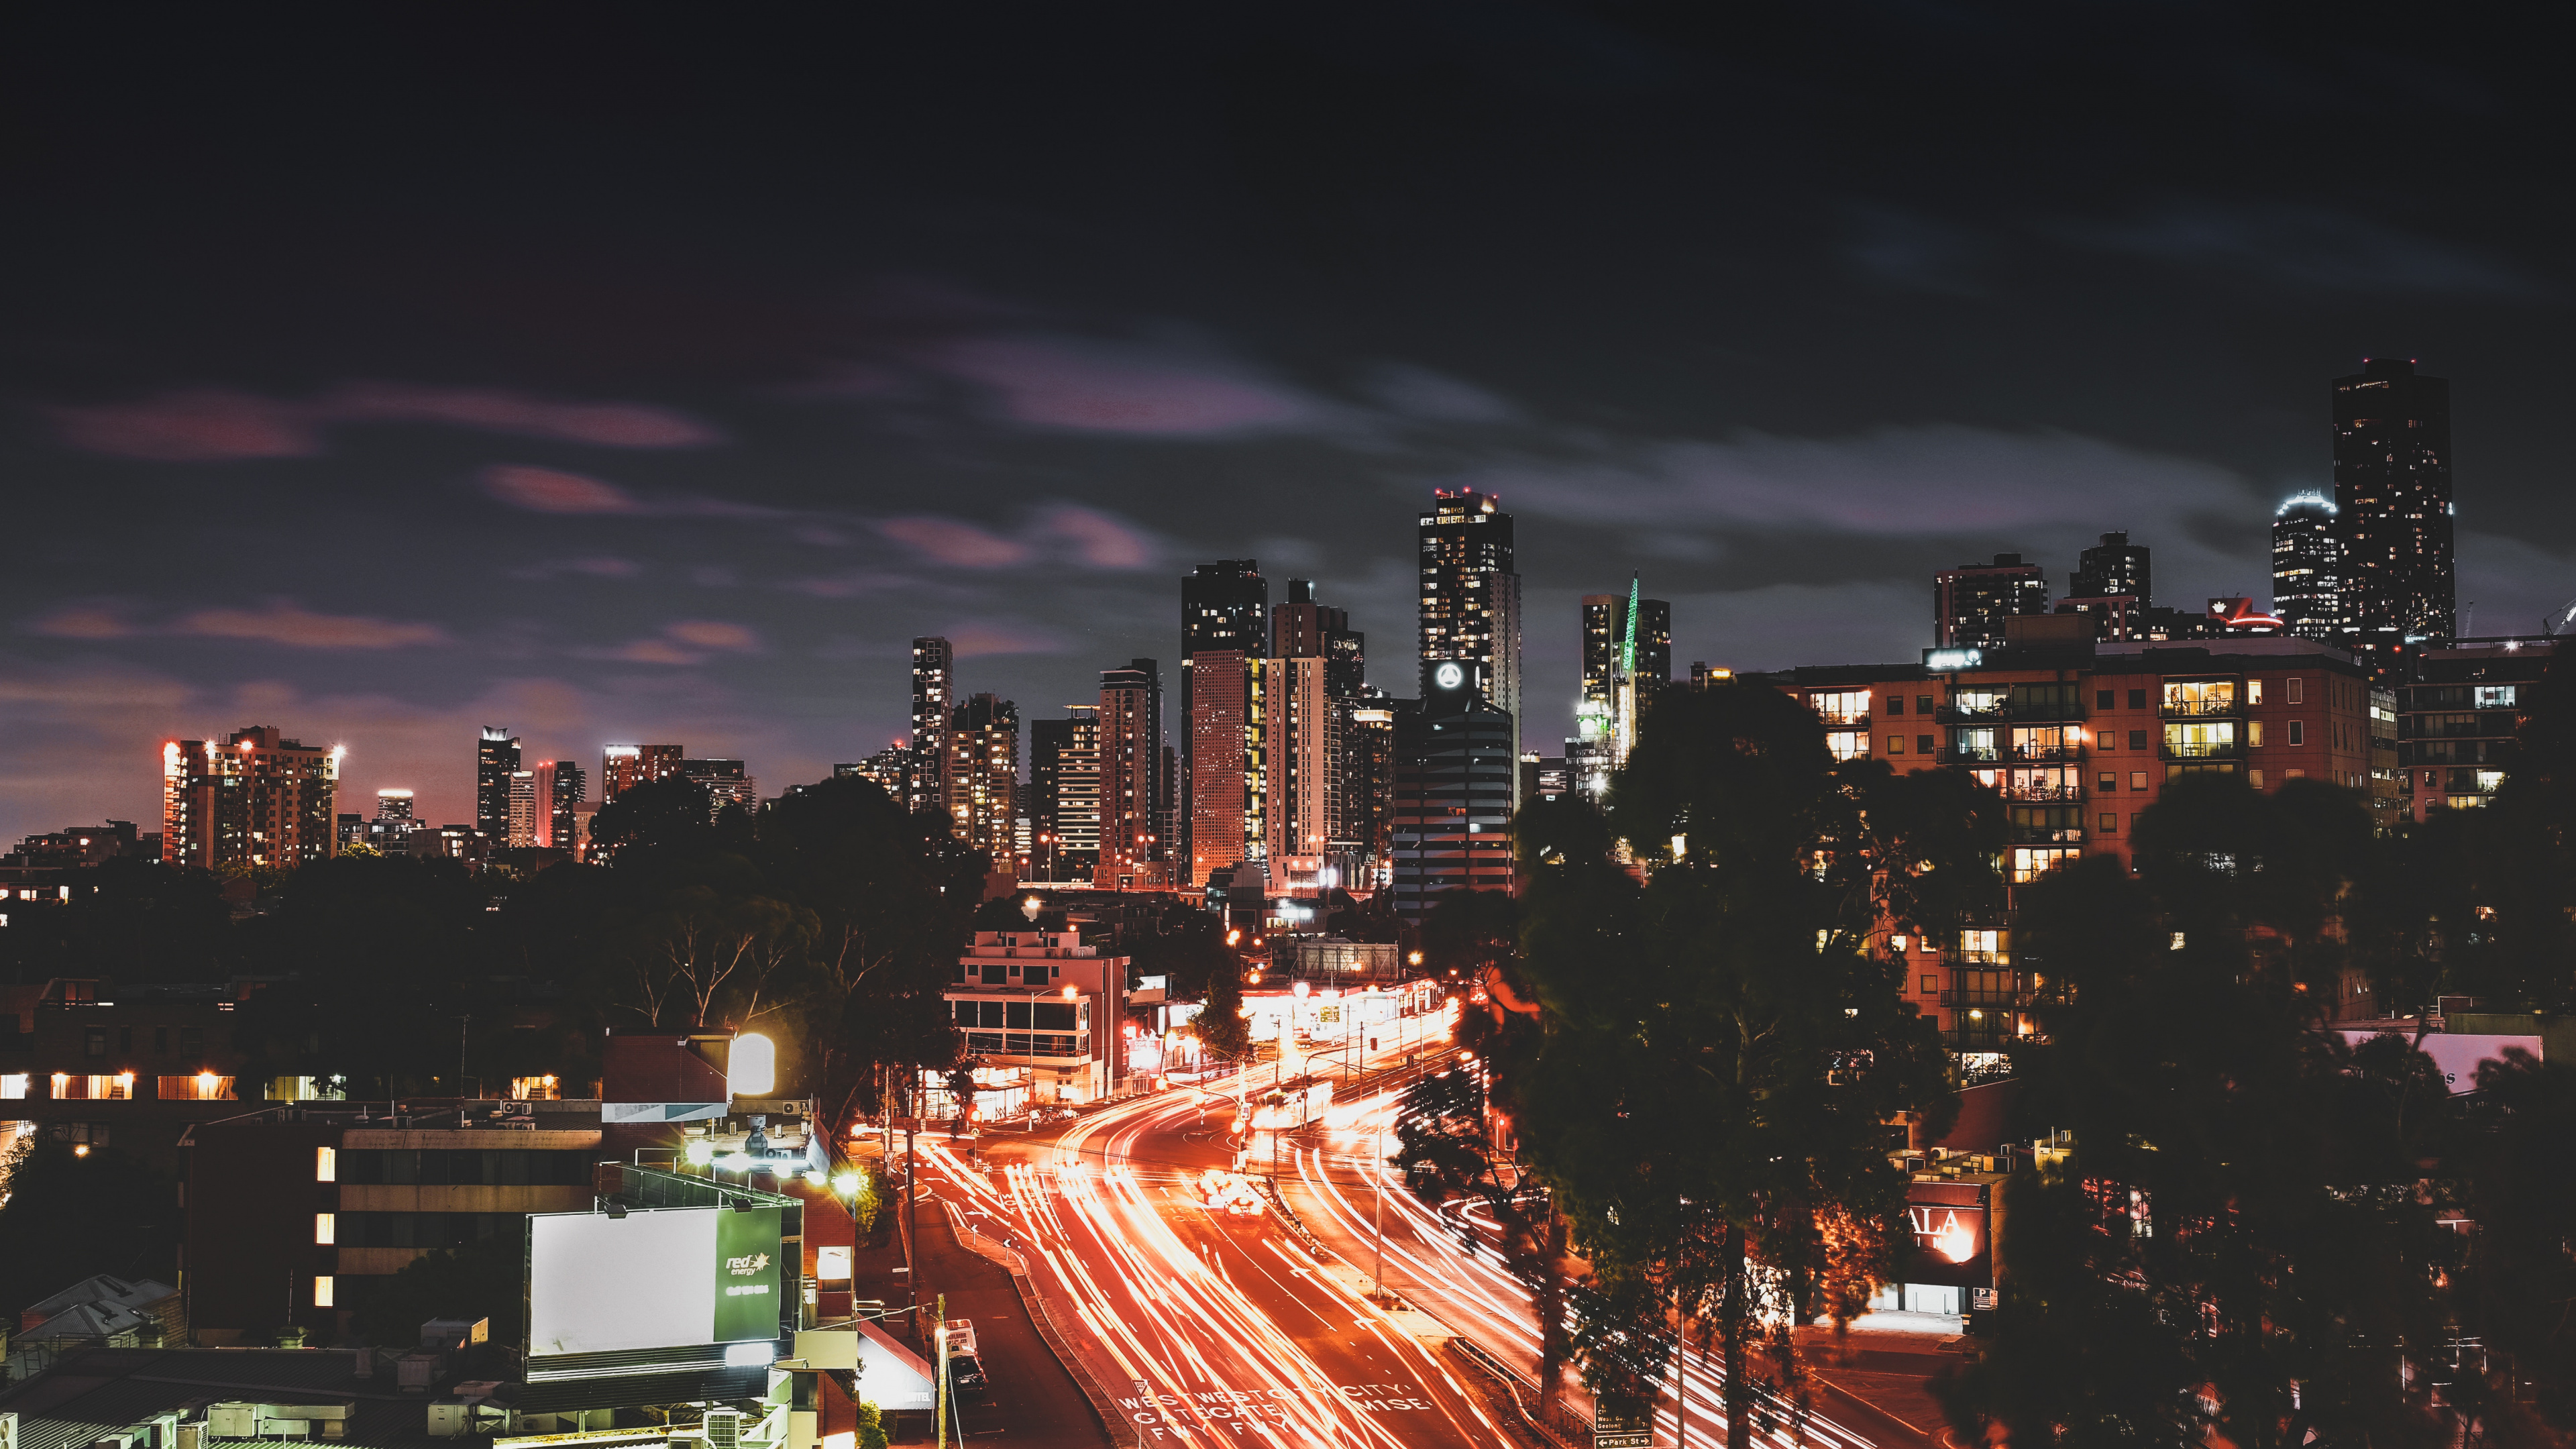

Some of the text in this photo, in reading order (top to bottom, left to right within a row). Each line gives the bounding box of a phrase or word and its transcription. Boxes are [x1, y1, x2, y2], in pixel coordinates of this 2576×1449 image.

[726, 1255, 753, 1269] red
[731, 1268, 756, 1276] energy
[1979, 1289, 1986, 1297] P
[1193, 1389, 1265, 1403] WEST
[1341, 1384, 1403, 1397] CITY
[1118, 1393, 1190, 1409] WEST
[1133, 1407, 1212, 1424] GATE
[1209, 1404, 1283, 1419] GATE
[1150, 1424, 1209, 1440] FWY
